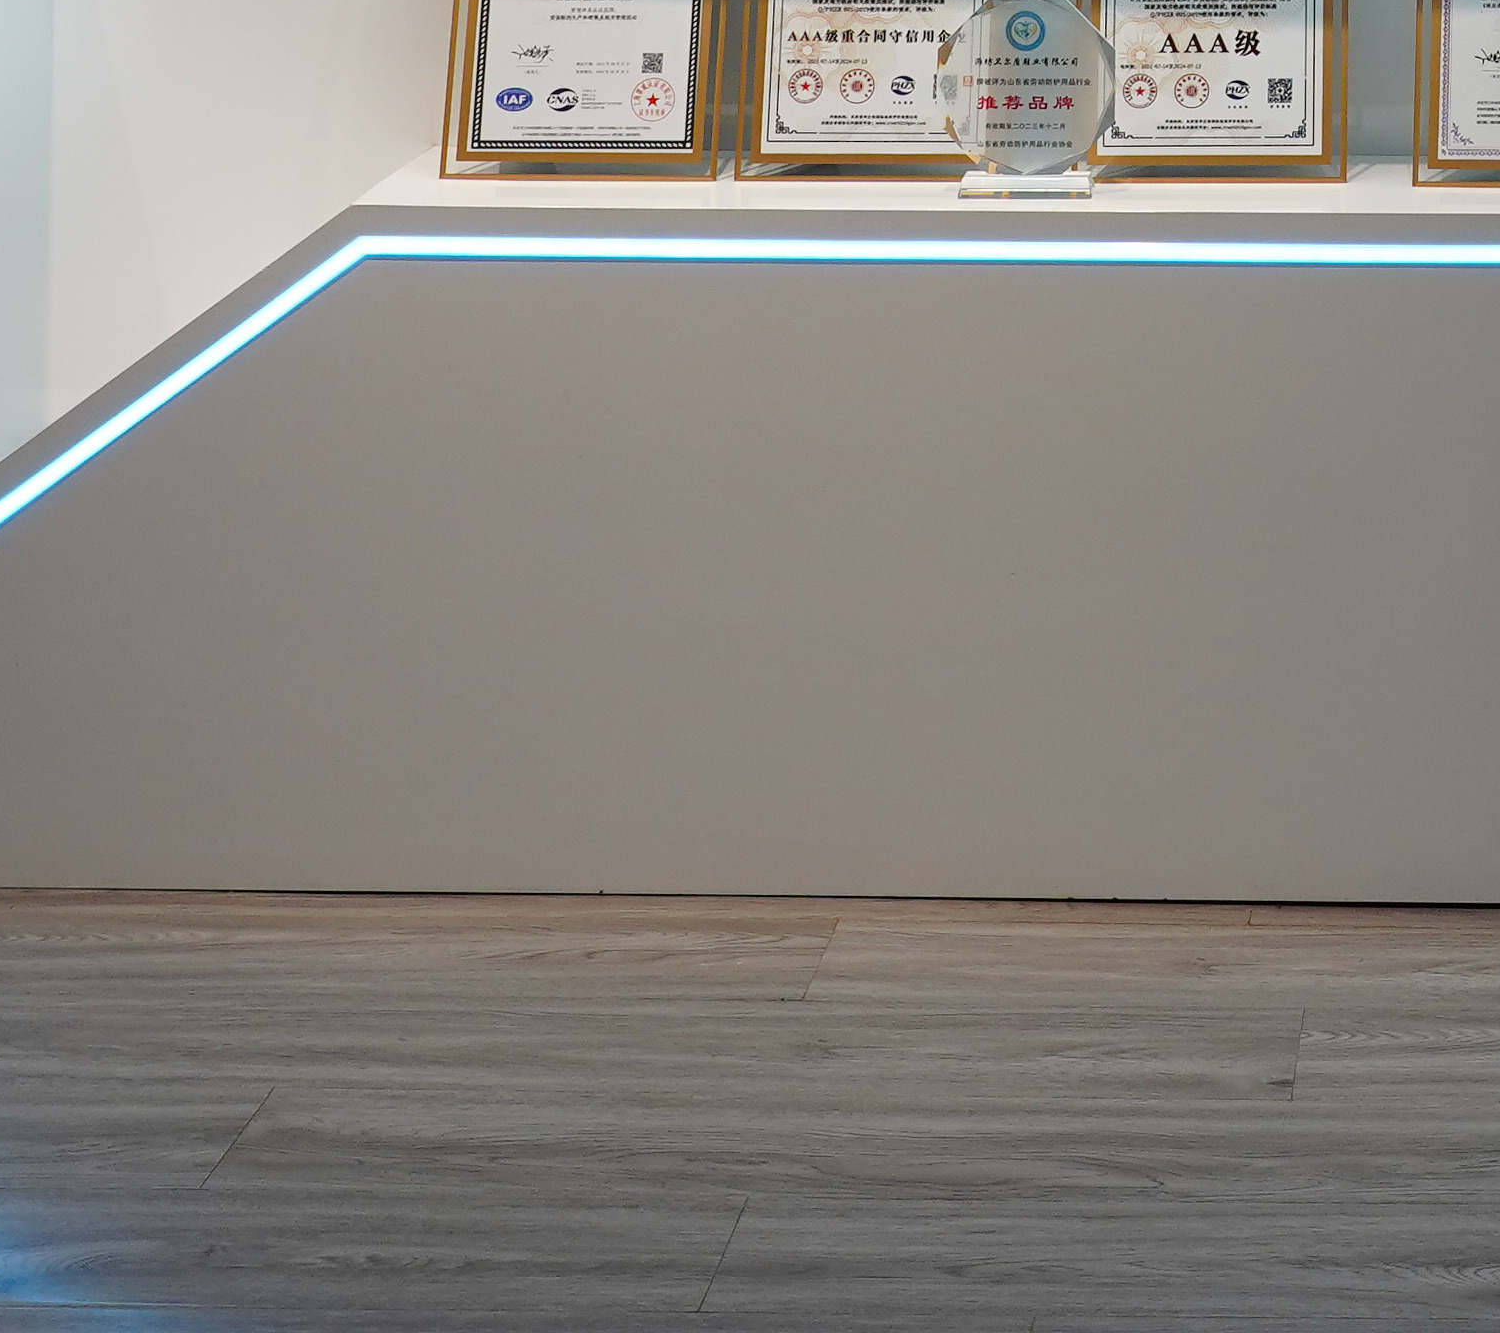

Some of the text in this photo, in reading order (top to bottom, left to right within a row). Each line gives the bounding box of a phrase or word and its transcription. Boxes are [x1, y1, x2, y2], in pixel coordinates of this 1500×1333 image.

[1160, 30, 1261, 57] AAA级
[502, 94, 527, 105] IAF
[547, 94, 579, 105] CNAS
[976, 95, 1075, 110] 推荐品牌
